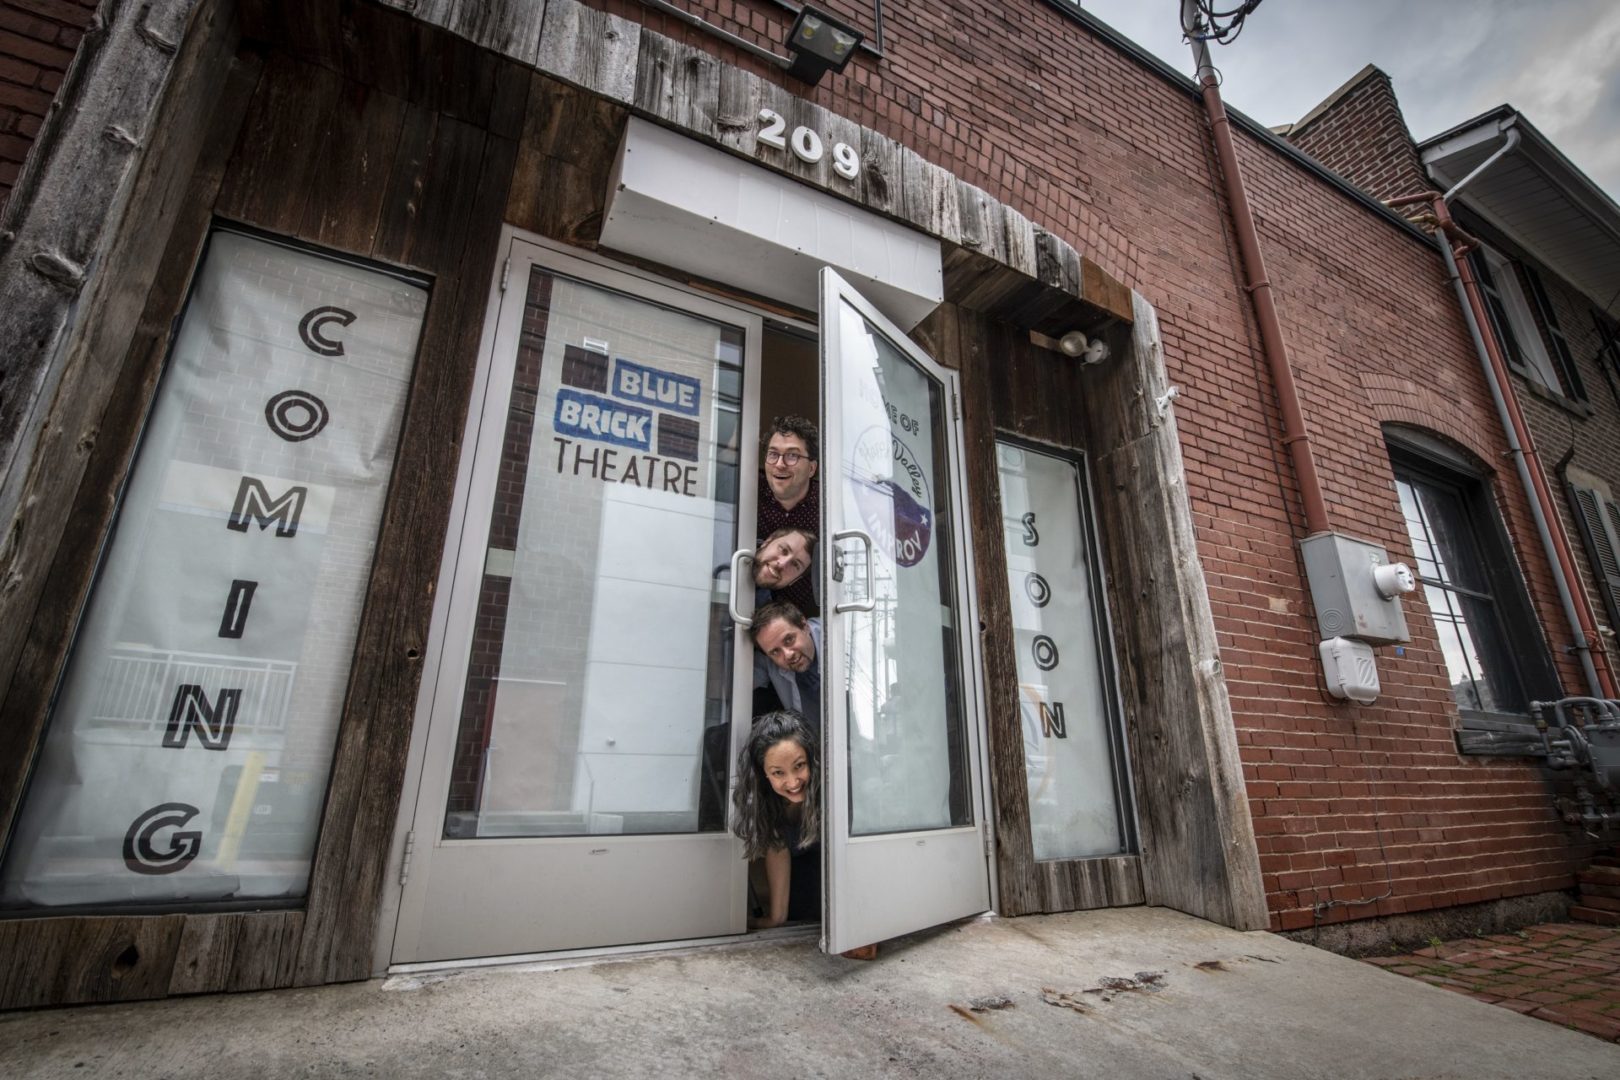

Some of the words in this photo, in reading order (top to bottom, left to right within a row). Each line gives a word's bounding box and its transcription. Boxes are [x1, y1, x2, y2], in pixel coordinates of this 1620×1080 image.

[757, 108, 860, 181] 209
[619, 368, 695, 409] BLUE
[559, 399, 650, 443] BRICK
[900, 413, 919, 436] OF
[553, 436, 699, 498] THEATRE
[892, 439, 922, 499] Valley
[122, 305, 357, 875] COMING
[1022, 512, 1068, 739] SOON
